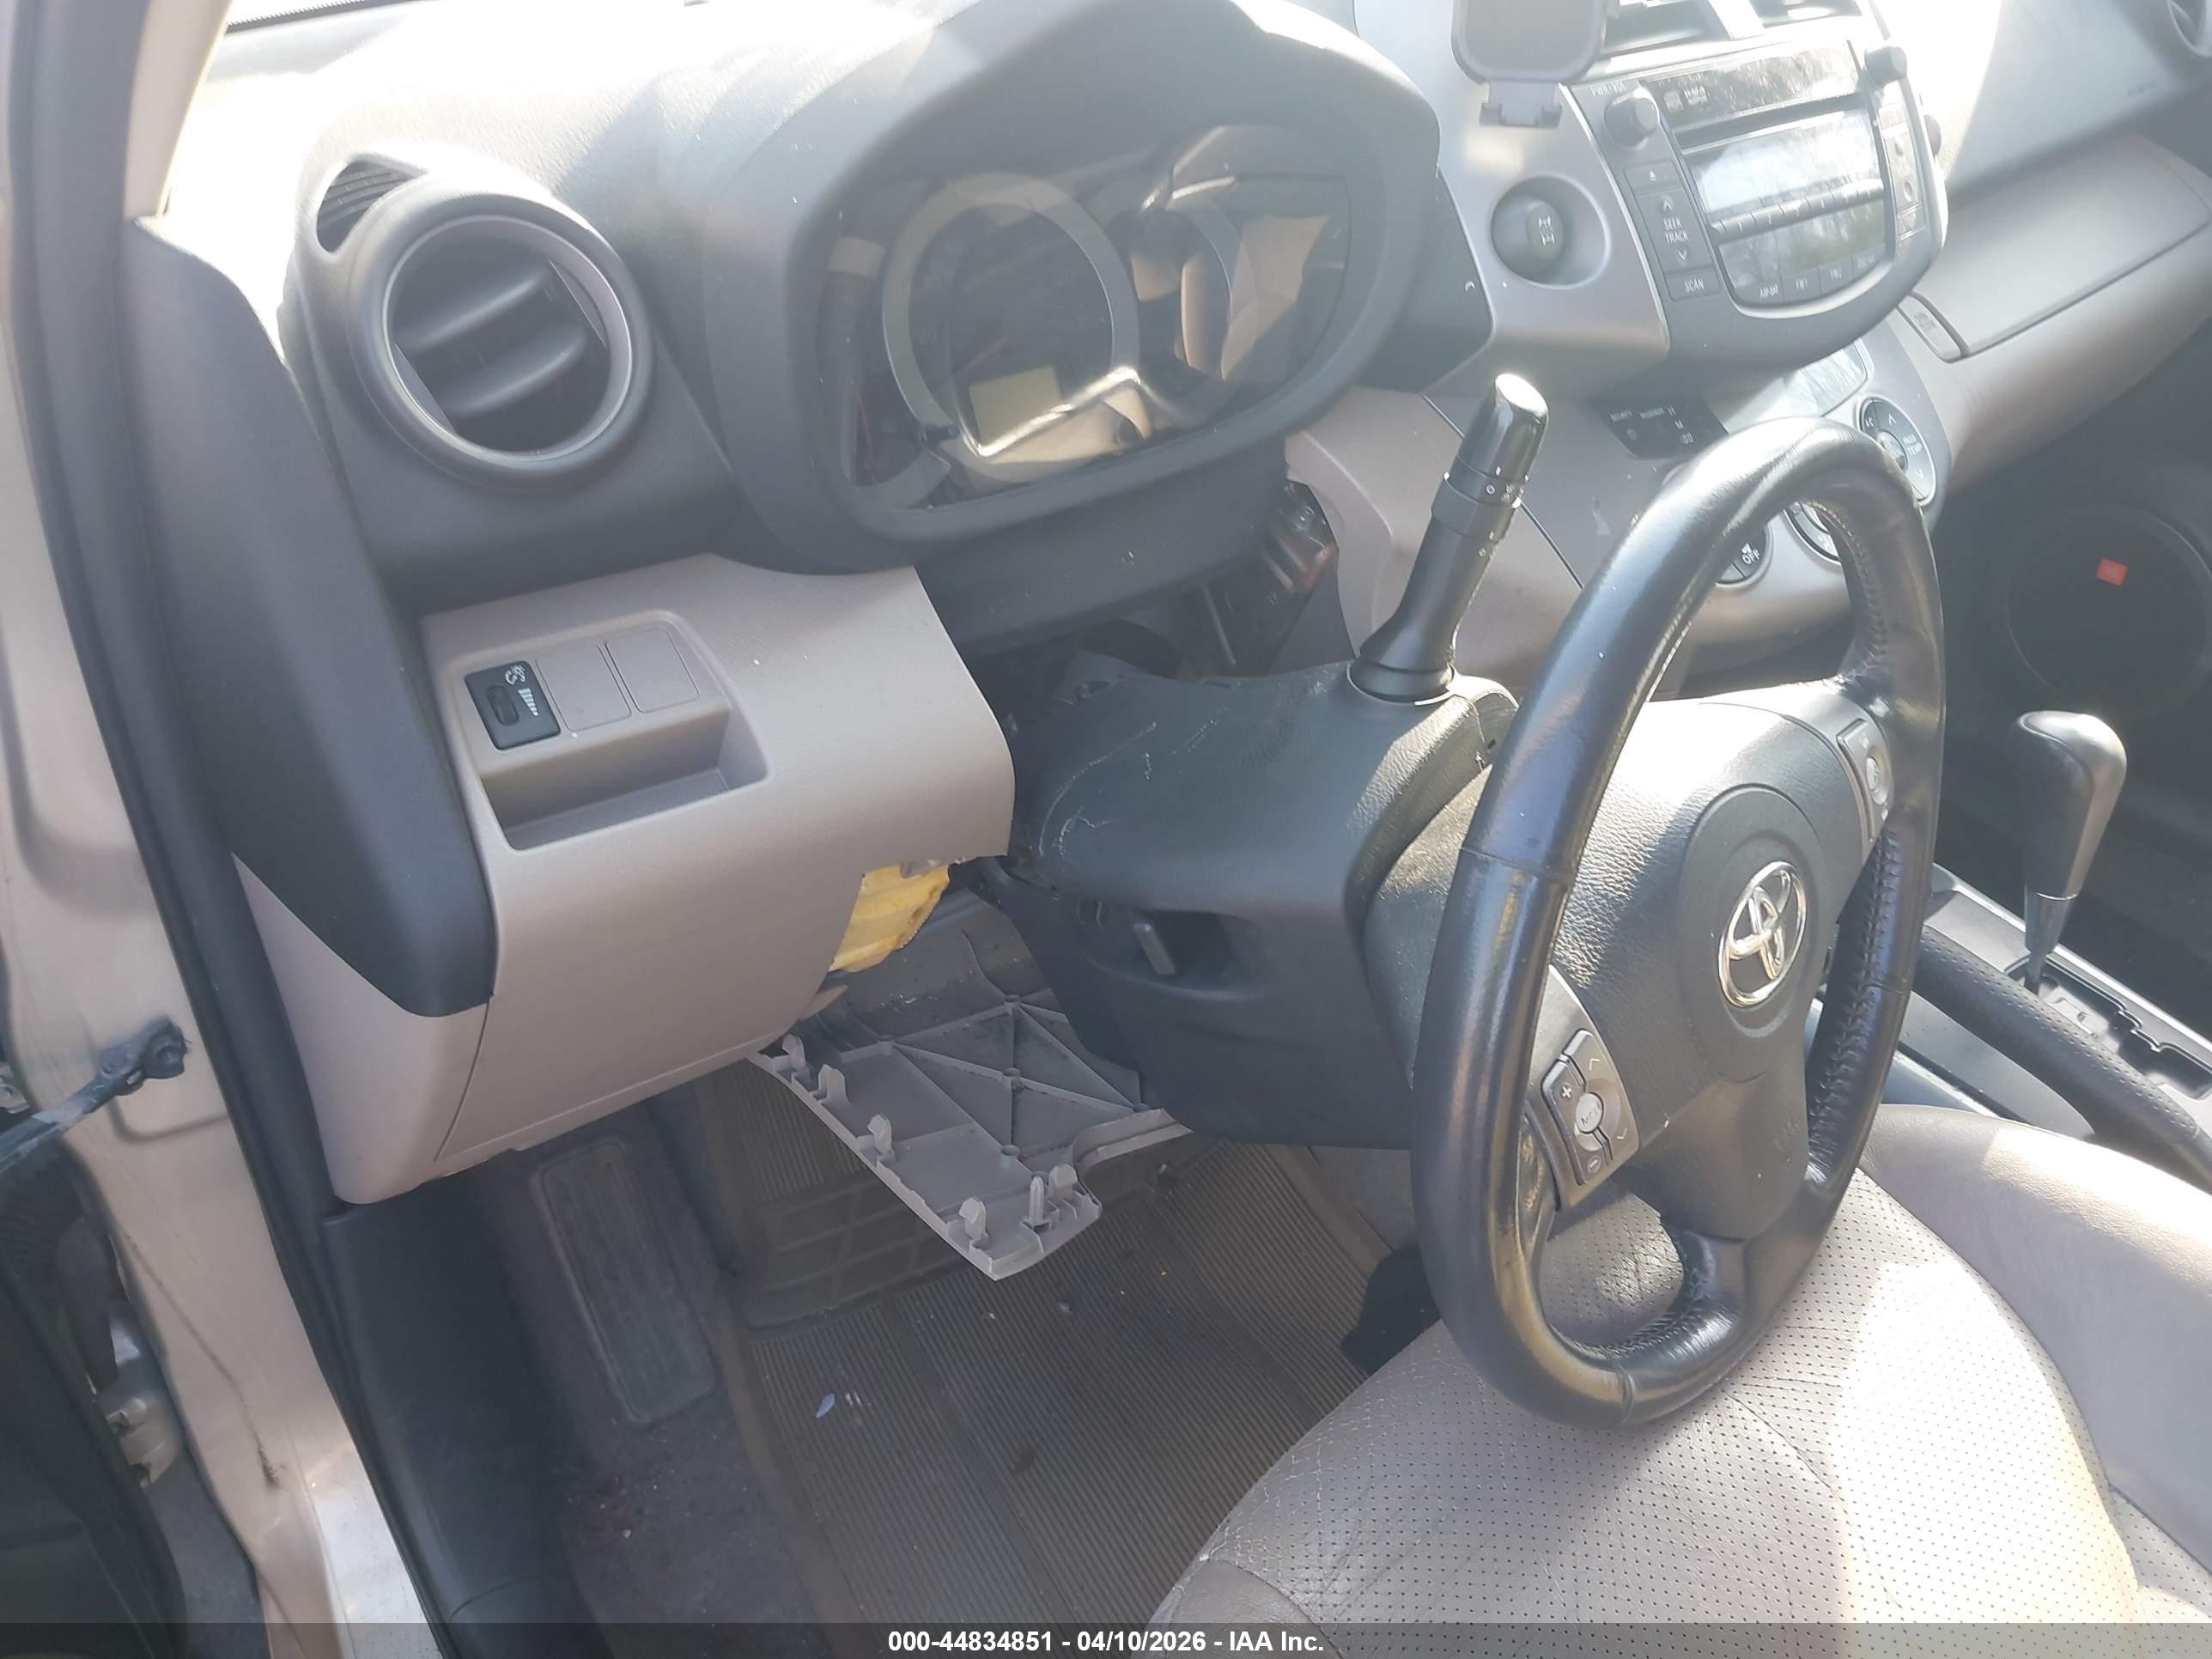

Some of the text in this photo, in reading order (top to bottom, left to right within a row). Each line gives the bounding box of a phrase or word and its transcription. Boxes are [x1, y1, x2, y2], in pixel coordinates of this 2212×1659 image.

[1665, 231, 1689, 245] TRACK
[1684, 278, 1705, 294] SCAN
[1741, 548, 1760, 564] OFF
